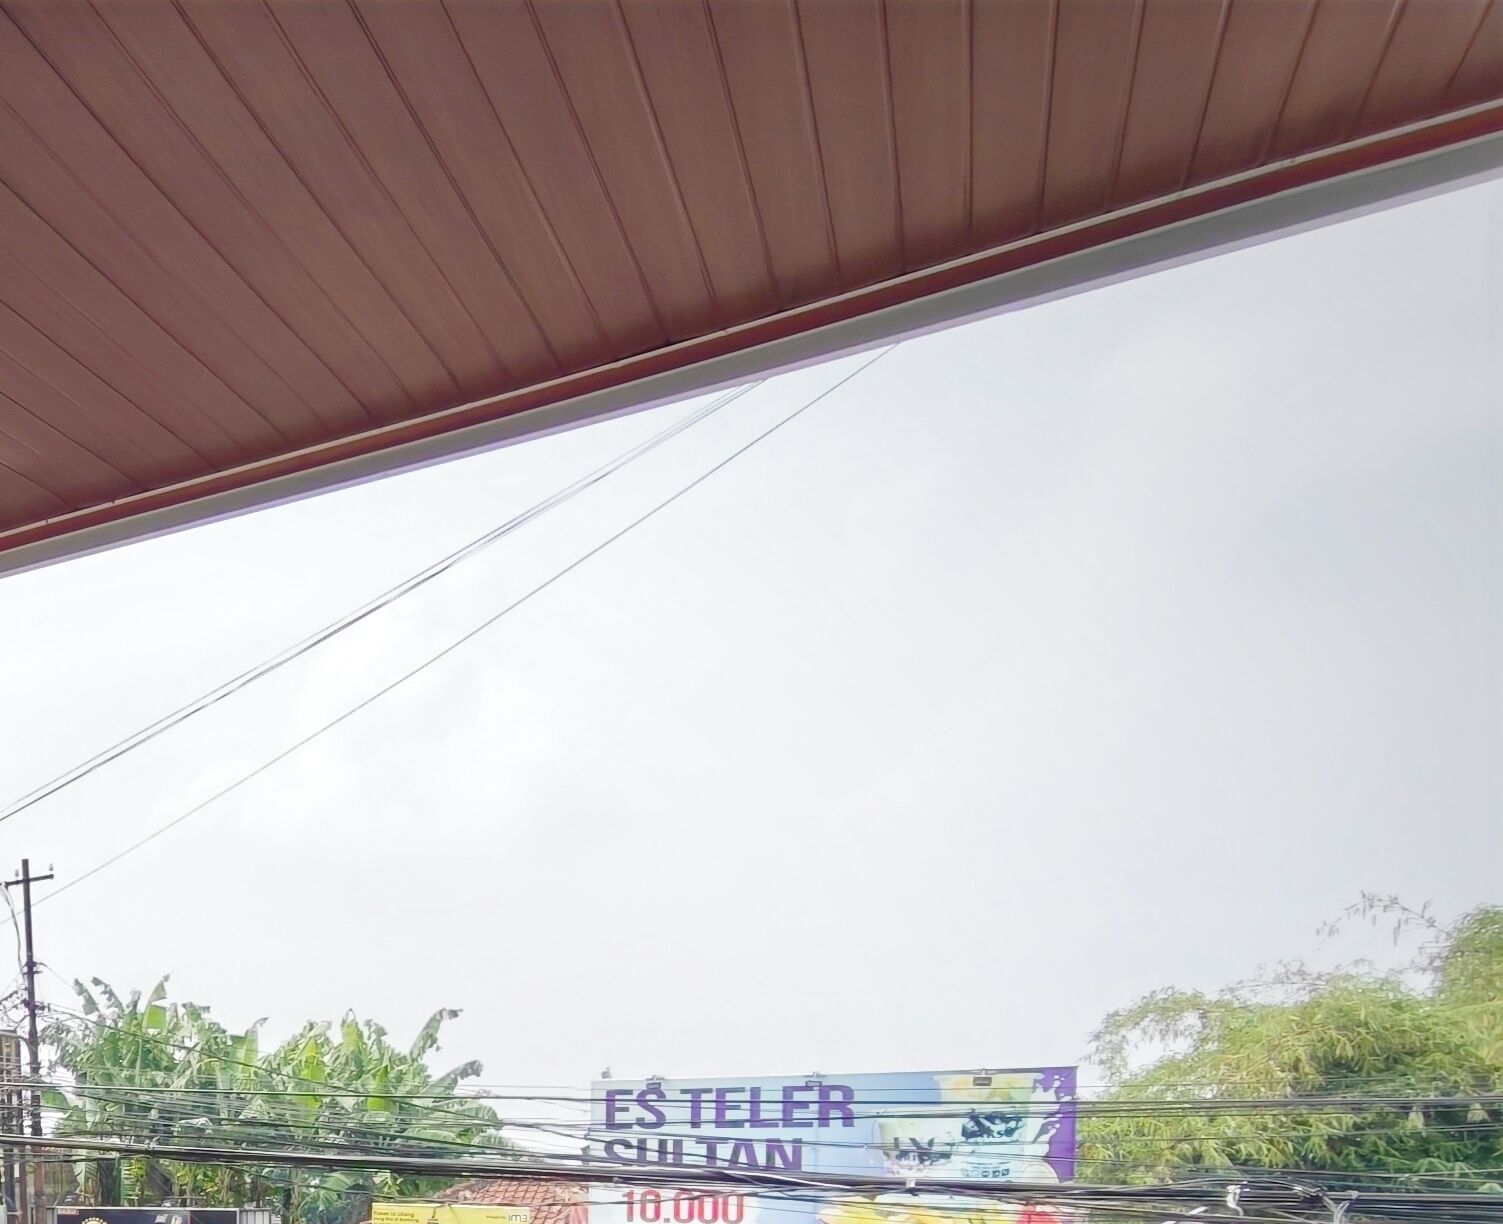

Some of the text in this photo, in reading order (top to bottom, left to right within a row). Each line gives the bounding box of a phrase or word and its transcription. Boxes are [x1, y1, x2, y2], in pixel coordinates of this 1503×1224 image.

[605, 1085, 855, 1130] ES TELER
[623, 1189, 745, 1224] 10.000
